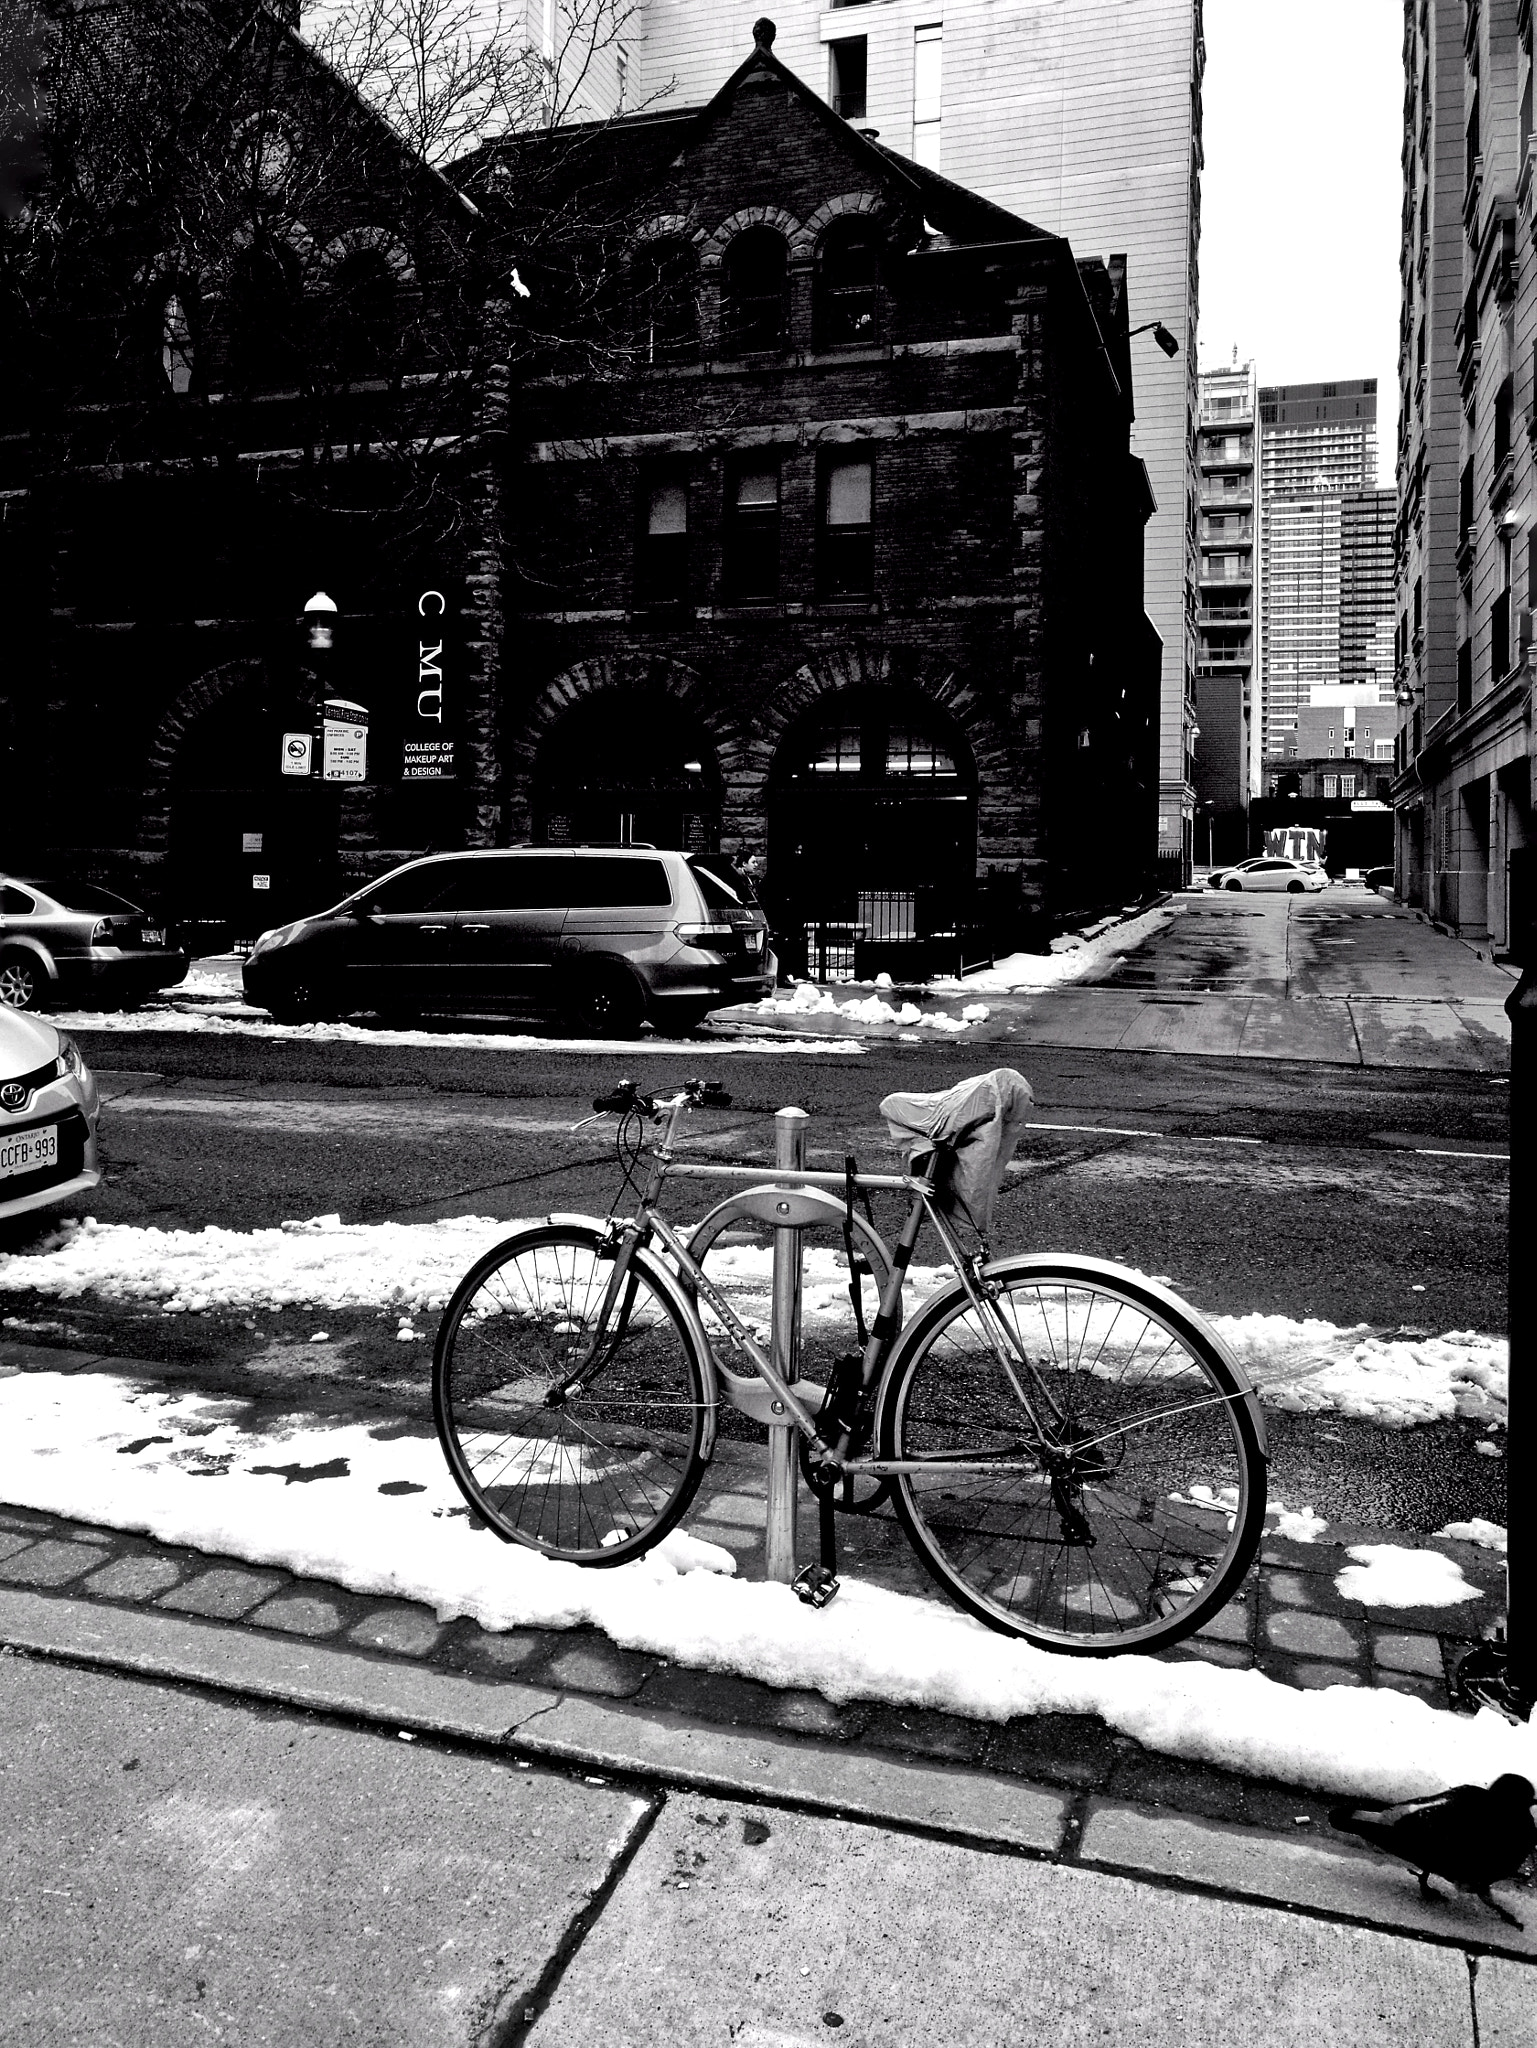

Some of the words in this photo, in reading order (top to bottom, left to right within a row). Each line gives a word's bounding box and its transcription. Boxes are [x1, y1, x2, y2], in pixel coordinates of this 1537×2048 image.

[404, 743, 440, 752] COLLEGE
[441, 742, 454, 751] OF
[404, 755, 437, 764] MAKEUP
[437, 754, 454, 763] ART
[403, 767, 410, 776] &
[411, 767, 442, 776] DESIGN
